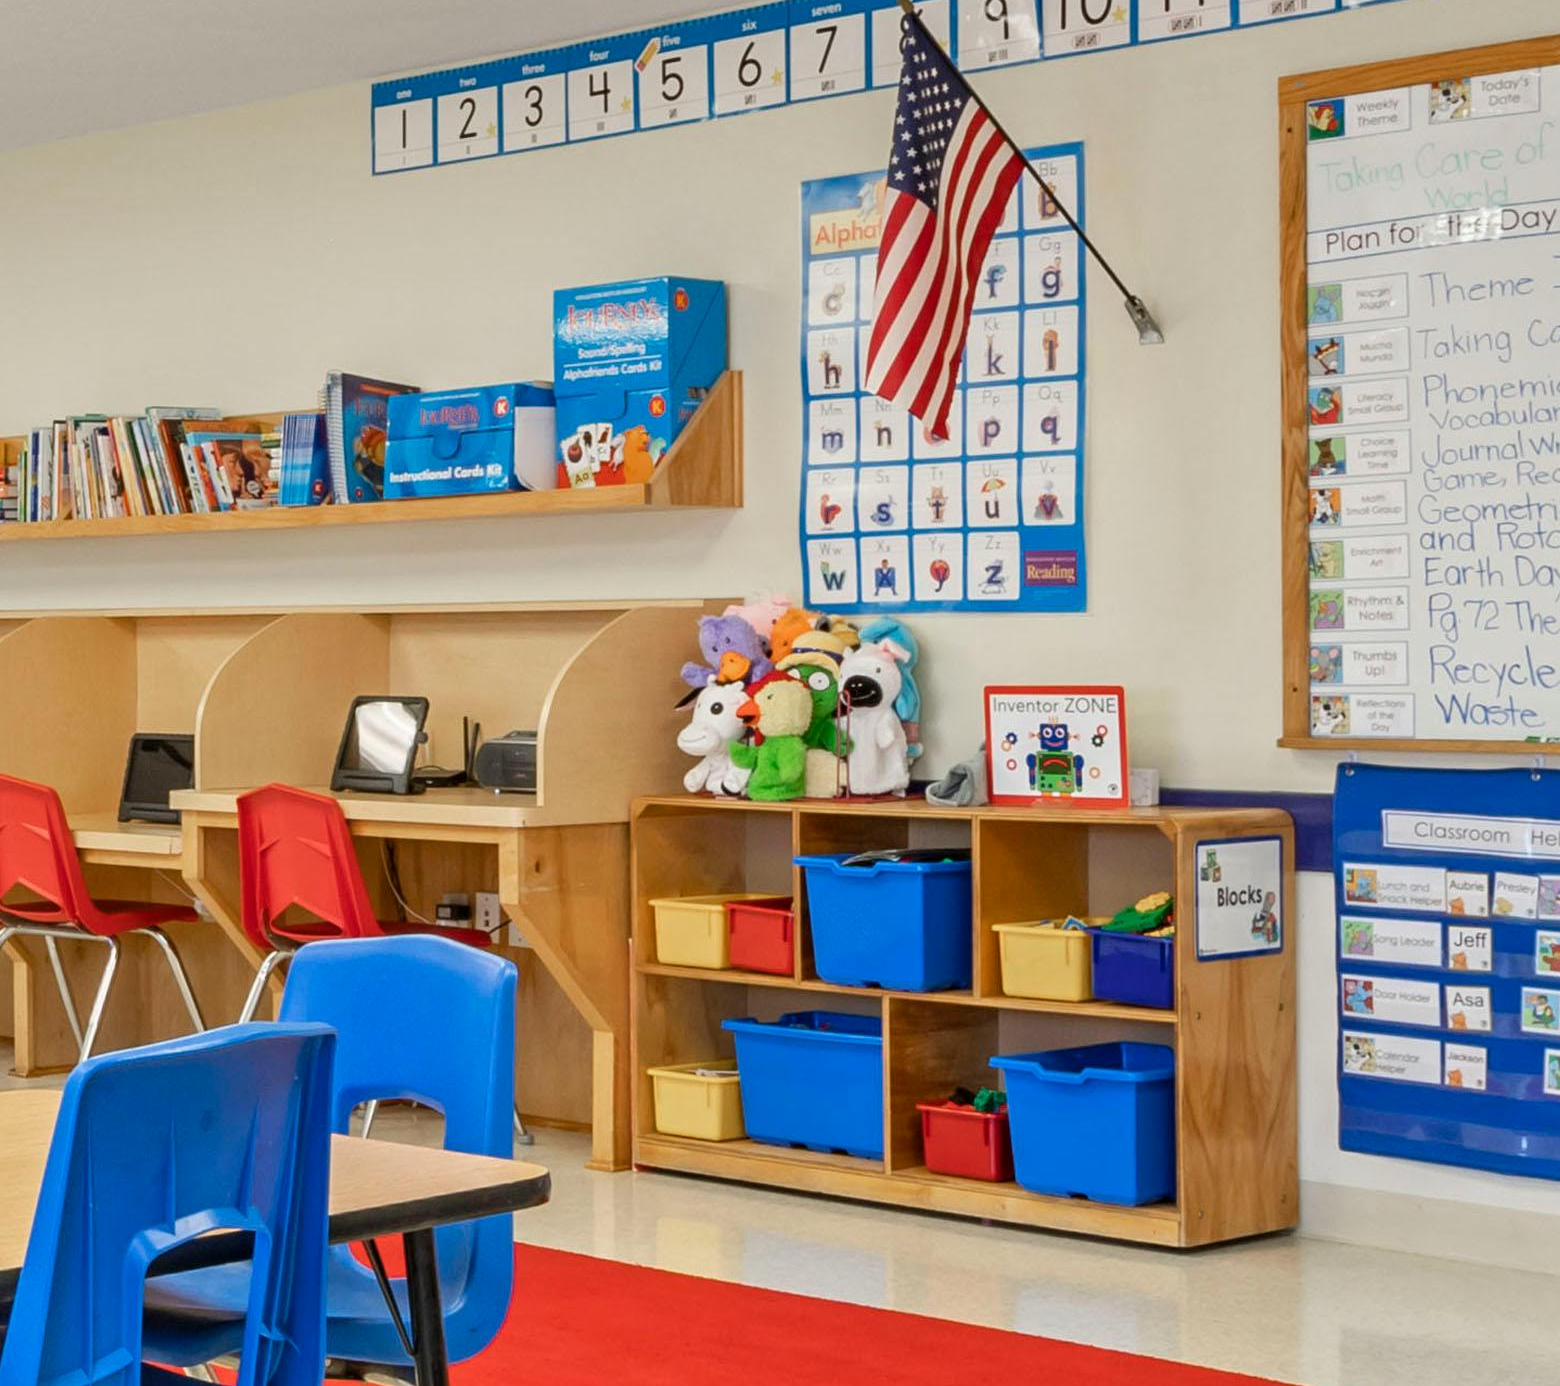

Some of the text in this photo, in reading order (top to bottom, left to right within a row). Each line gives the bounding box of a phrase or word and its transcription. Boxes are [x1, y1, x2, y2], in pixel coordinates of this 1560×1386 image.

[810, 2, 843, 17] seven
[740, 18, 759, 32] six
[661, 33, 682, 47] five
[815, 25, 839, 75] 7
[588, 48, 610, 62] four
[738, 42, 762, 88] 6
[521, 62, 547, 75] three
[458, 75, 477, 88] two
[661, 57, 684, 103] 5
[1480, 76, 1531, 93] Today's
[396, 88, 413, 99] one
[588, 70, 612, 115] 4
[1488, 93, 1521, 107] Date
[523, 84, 544, 128] 3
[1356, 99, 1399, 113] Weekly
[459, 97, 478, 140] 2
[1356, 113, 1399, 128] Theme
[401, 108, 408, 151] 1
[1416, 141, 1504, 180] Care
[1516, 120, 1555, 165] of
[1325, 231, 1381, 254] Plan
[1389, 223, 1425, 245] for
[1500, 207, 1558, 233] Day
[1419, 270, 1535, 308] Theme
[1416, 323, 1512, 363] Taking
[621, 361, 647, 375] Cards
[649, 360, 663, 373] Kit
[1421, 430, 1524, 469] Journal
[388, 462, 503, 485] Instructional Cards Kit
[1419, 519, 1476, 553] and
[1026, 563, 1076, 585] Reading
[1424, 556, 1504, 589] Earth
[1347, 594, 1405, 609] Rhythm &
[1359, 609, 1394, 621] Notes
[1463, 599, 1500, 631] 72
[1505, 599, 1560, 635] The
[1352, 650, 1398, 663] Thumbs
[1365, 664, 1386, 678] Up!
[1428, 644, 1560, 698] Recycle
[993, 696, 1117, 714] Inventor ZONE
[1434, 692, 1547, 728] Waste
[1413, 820, 1511, 845] Classroom
[1215, 885, 1264, 909] Blocks
[1497, 879, 1536, 897] Presley
[1453, 930, 1488, 949] Jeff
[1452, 991, 1484, 1008] Asa
[1447, 1051, 1485, 1066] Jackson
